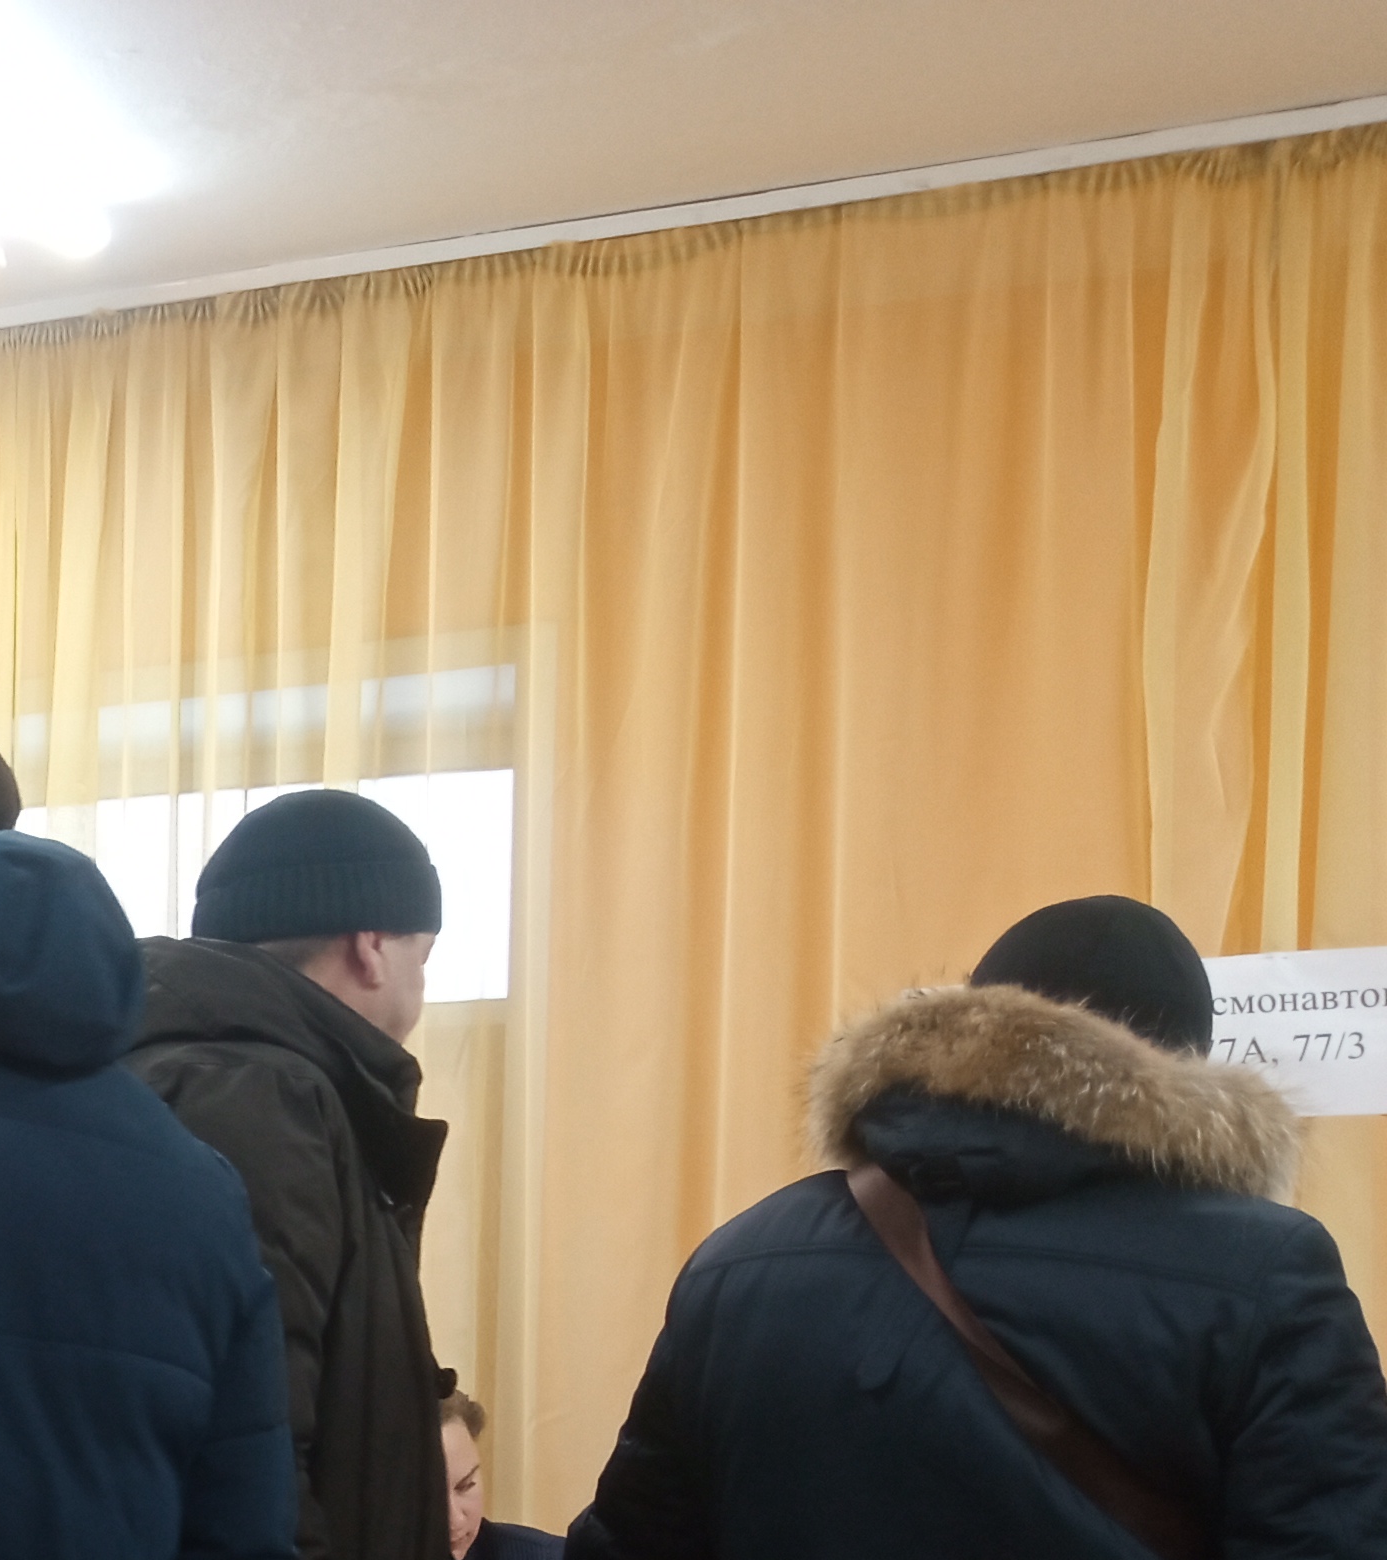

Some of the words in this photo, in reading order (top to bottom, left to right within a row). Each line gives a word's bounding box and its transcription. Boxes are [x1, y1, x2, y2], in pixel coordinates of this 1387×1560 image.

[1212, 987, 1387, 1017] смонавто
[1210, 1035, 1280, 1068] 7А,
[1293, 1031, 1366, 1063] 77/3
